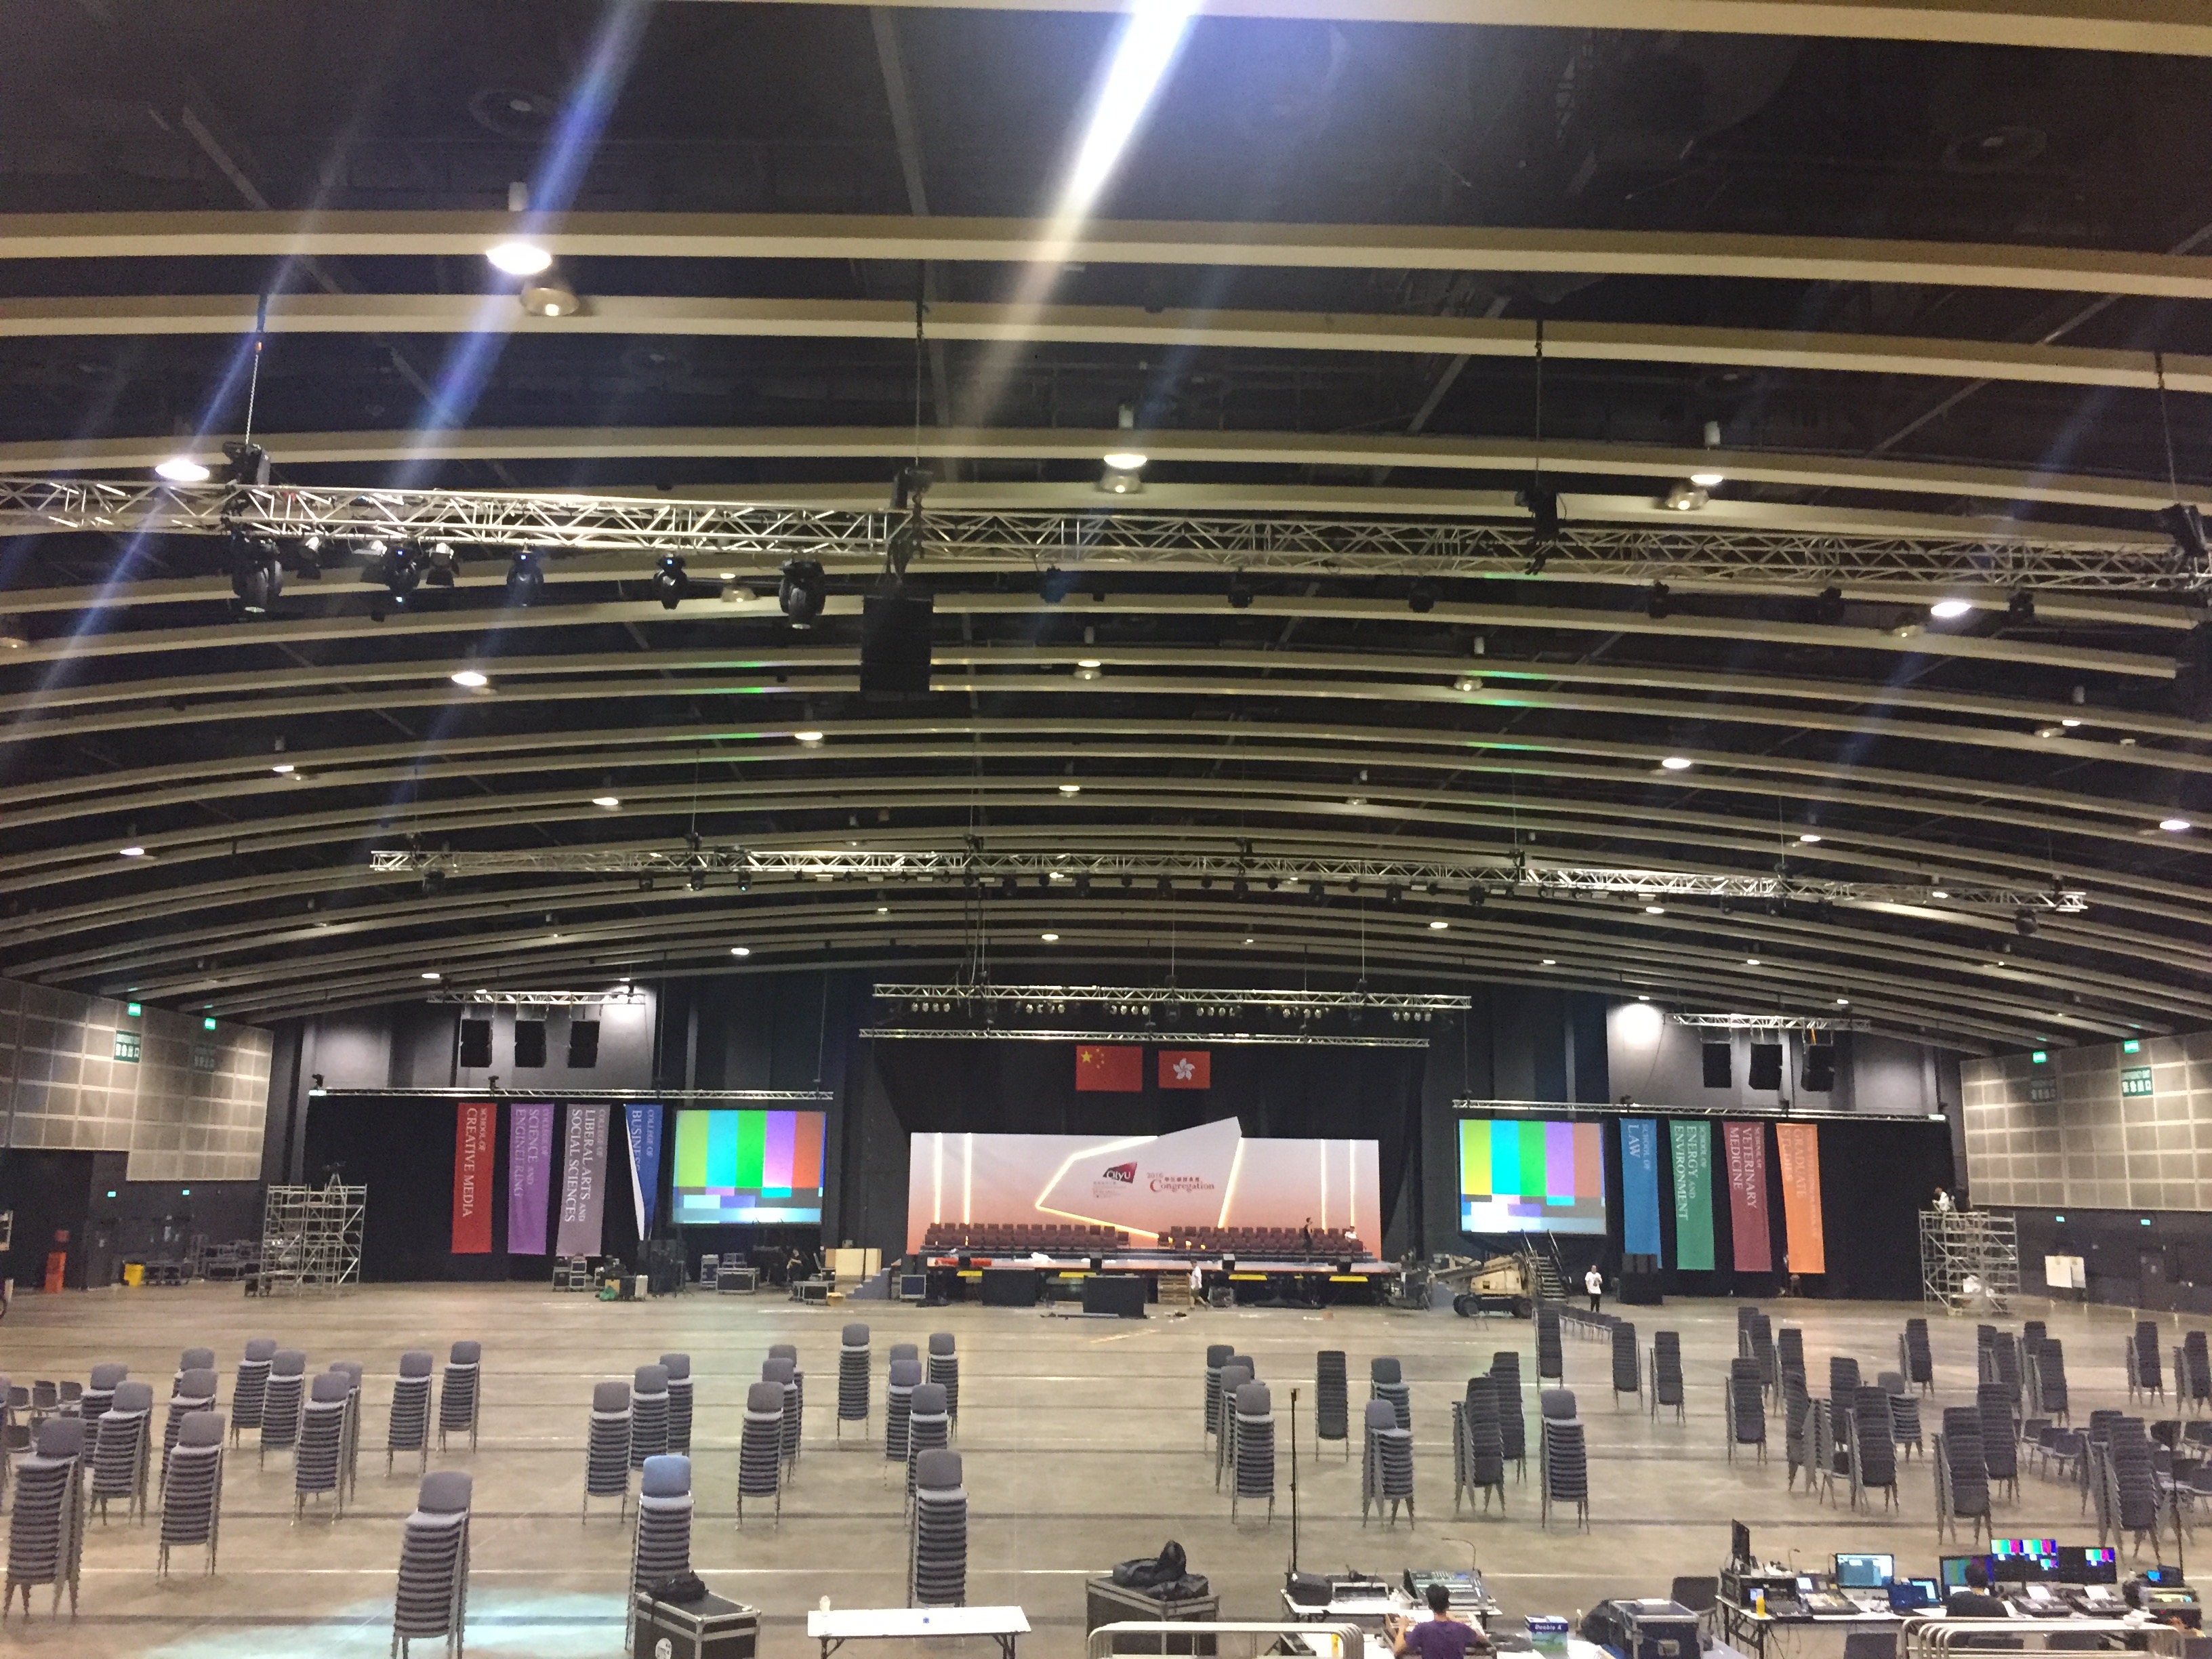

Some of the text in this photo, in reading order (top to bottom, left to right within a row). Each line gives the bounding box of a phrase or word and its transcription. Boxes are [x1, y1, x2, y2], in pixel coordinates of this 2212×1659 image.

[478, 1107, 487, 1151] SCHOOL OF
[514, 1109, 527, 1197] ENGINEERING
[527, 1109, 539, 1185] SCIENCE AND
[596, 1108, 606, 1158] COLLEGE OF
[647, 1109, 655, 1158] COLLEGE OF
[1628, 1124, 1641, 1159] LAW
[1642, 1124, 1650, 1171] SCHOOL OF
[1699, 1126, 1707, 1168] SCHOOL OF
[1729, 1127, 1743, 1190] MEDICINE
[1781, 1128, 1794, 1182] STUDIES
[462, 1107, 478, 1217] CREATIVE MEDIA
[565, 1109, 583, 1222] SOCIAL SCIENCES
[578, 1109, 596, 1222] LIBERAL ARTS AND
[1106, 1170, 1131, 1182] CityU
[1149, 1179, 1214, 1193] Congregation
[1674, 1126, 1688, 1221] ENVIRONMENT
[1687, 1126, 1698, 1199] ENERGY AND
[1742, 1128, 1757, 1209] VETERINARY
[1794, 1128, 1807, 1199] GRADUATE
